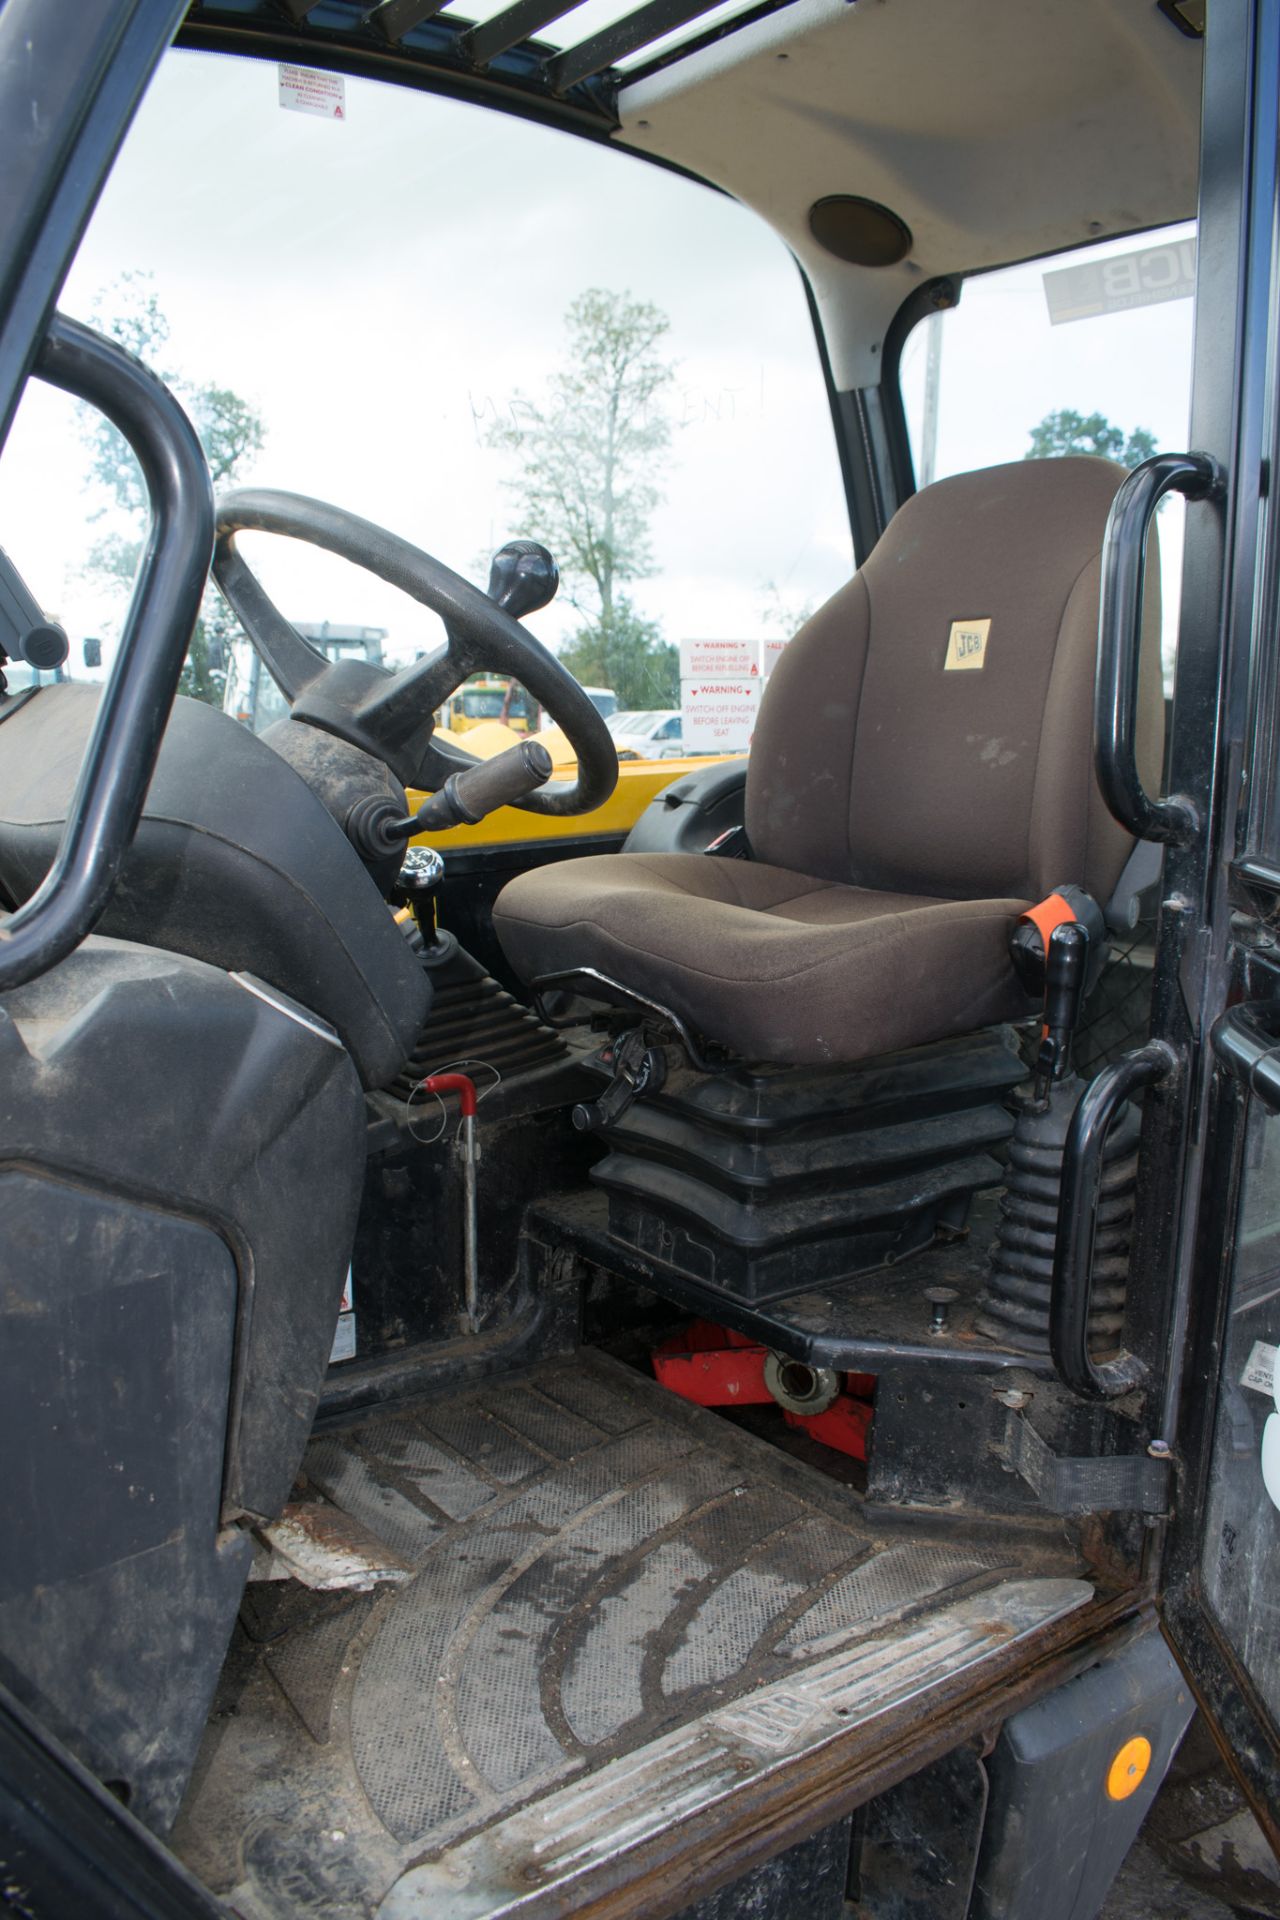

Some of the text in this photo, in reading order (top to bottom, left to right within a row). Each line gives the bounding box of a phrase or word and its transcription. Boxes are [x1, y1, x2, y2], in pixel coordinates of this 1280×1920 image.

[285, 81, 305, 91] CLEAN
[305, 86, 338, 98] CONDITION
[703, 642, 739, 650] WARNING
[958, 634, 981, 657] JCB
[690, 655, 715, 664] SWITCH
[716, 655, 738, 664] ENGINE
[692, 664, 713, 672] BEFORE
[700, 685, 743, 695] WARNING
[686, 705, 756, 714] SWITCH OFF ENGINE
[693, 716, 750, 726] BEFORE LEAVING
[713, 728, 729, 737] SEAT
